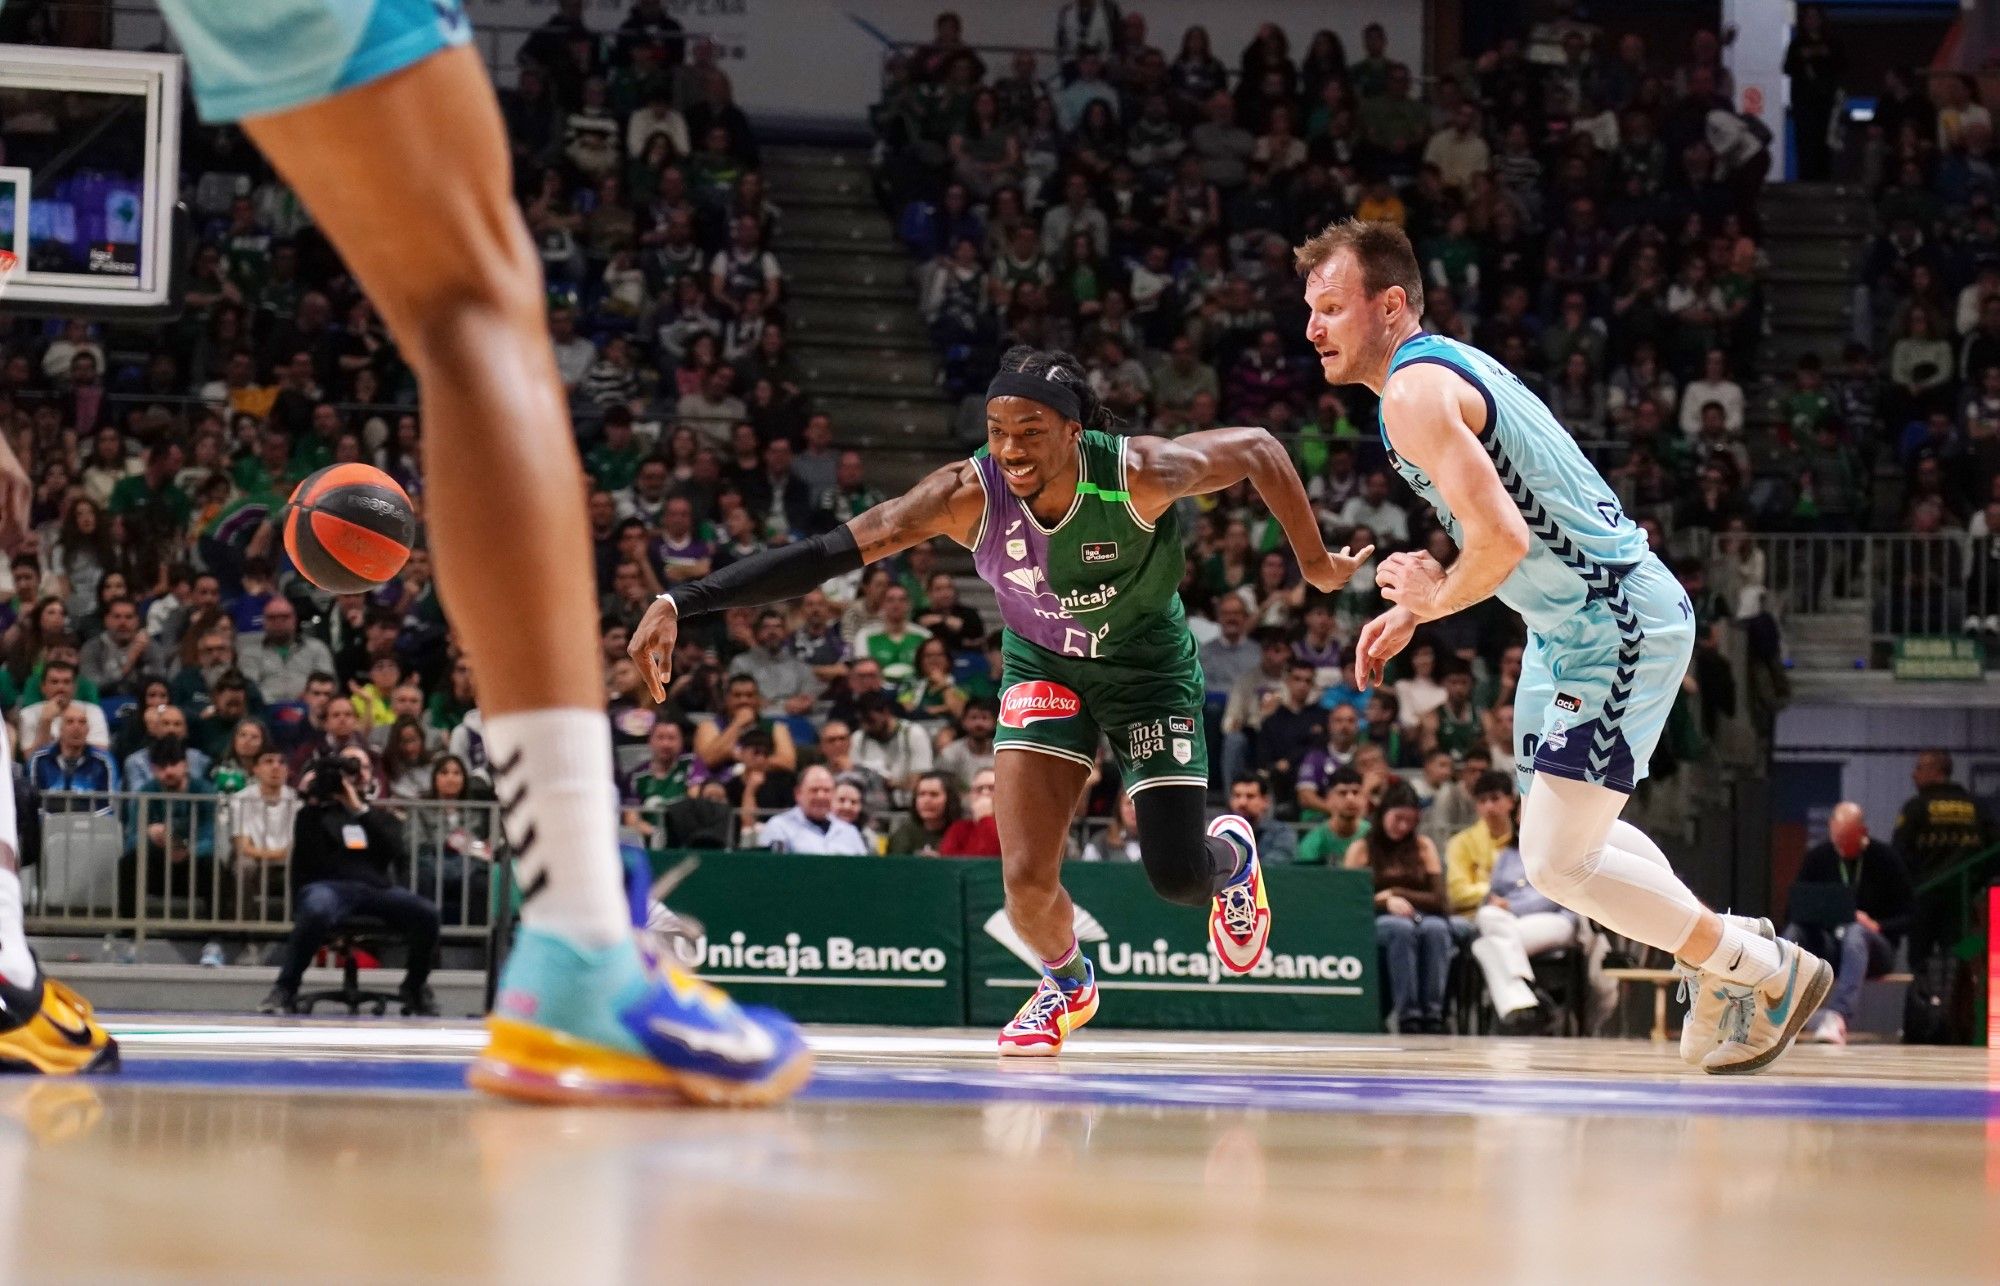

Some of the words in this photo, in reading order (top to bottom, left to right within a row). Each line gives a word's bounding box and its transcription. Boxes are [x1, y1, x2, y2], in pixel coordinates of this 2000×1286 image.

[1055, 583, 1118, 607] nicaja
[1002, 686, 1077, 720] famadesa
[1557, 699, 1575, 711] acb
[1172, 722, 1189, 731] acb
[674, 931, 823, 977] Unicaja
[827, 937, 947, 972] Banco
[1099, 938, 1238, 984] Unicaj
